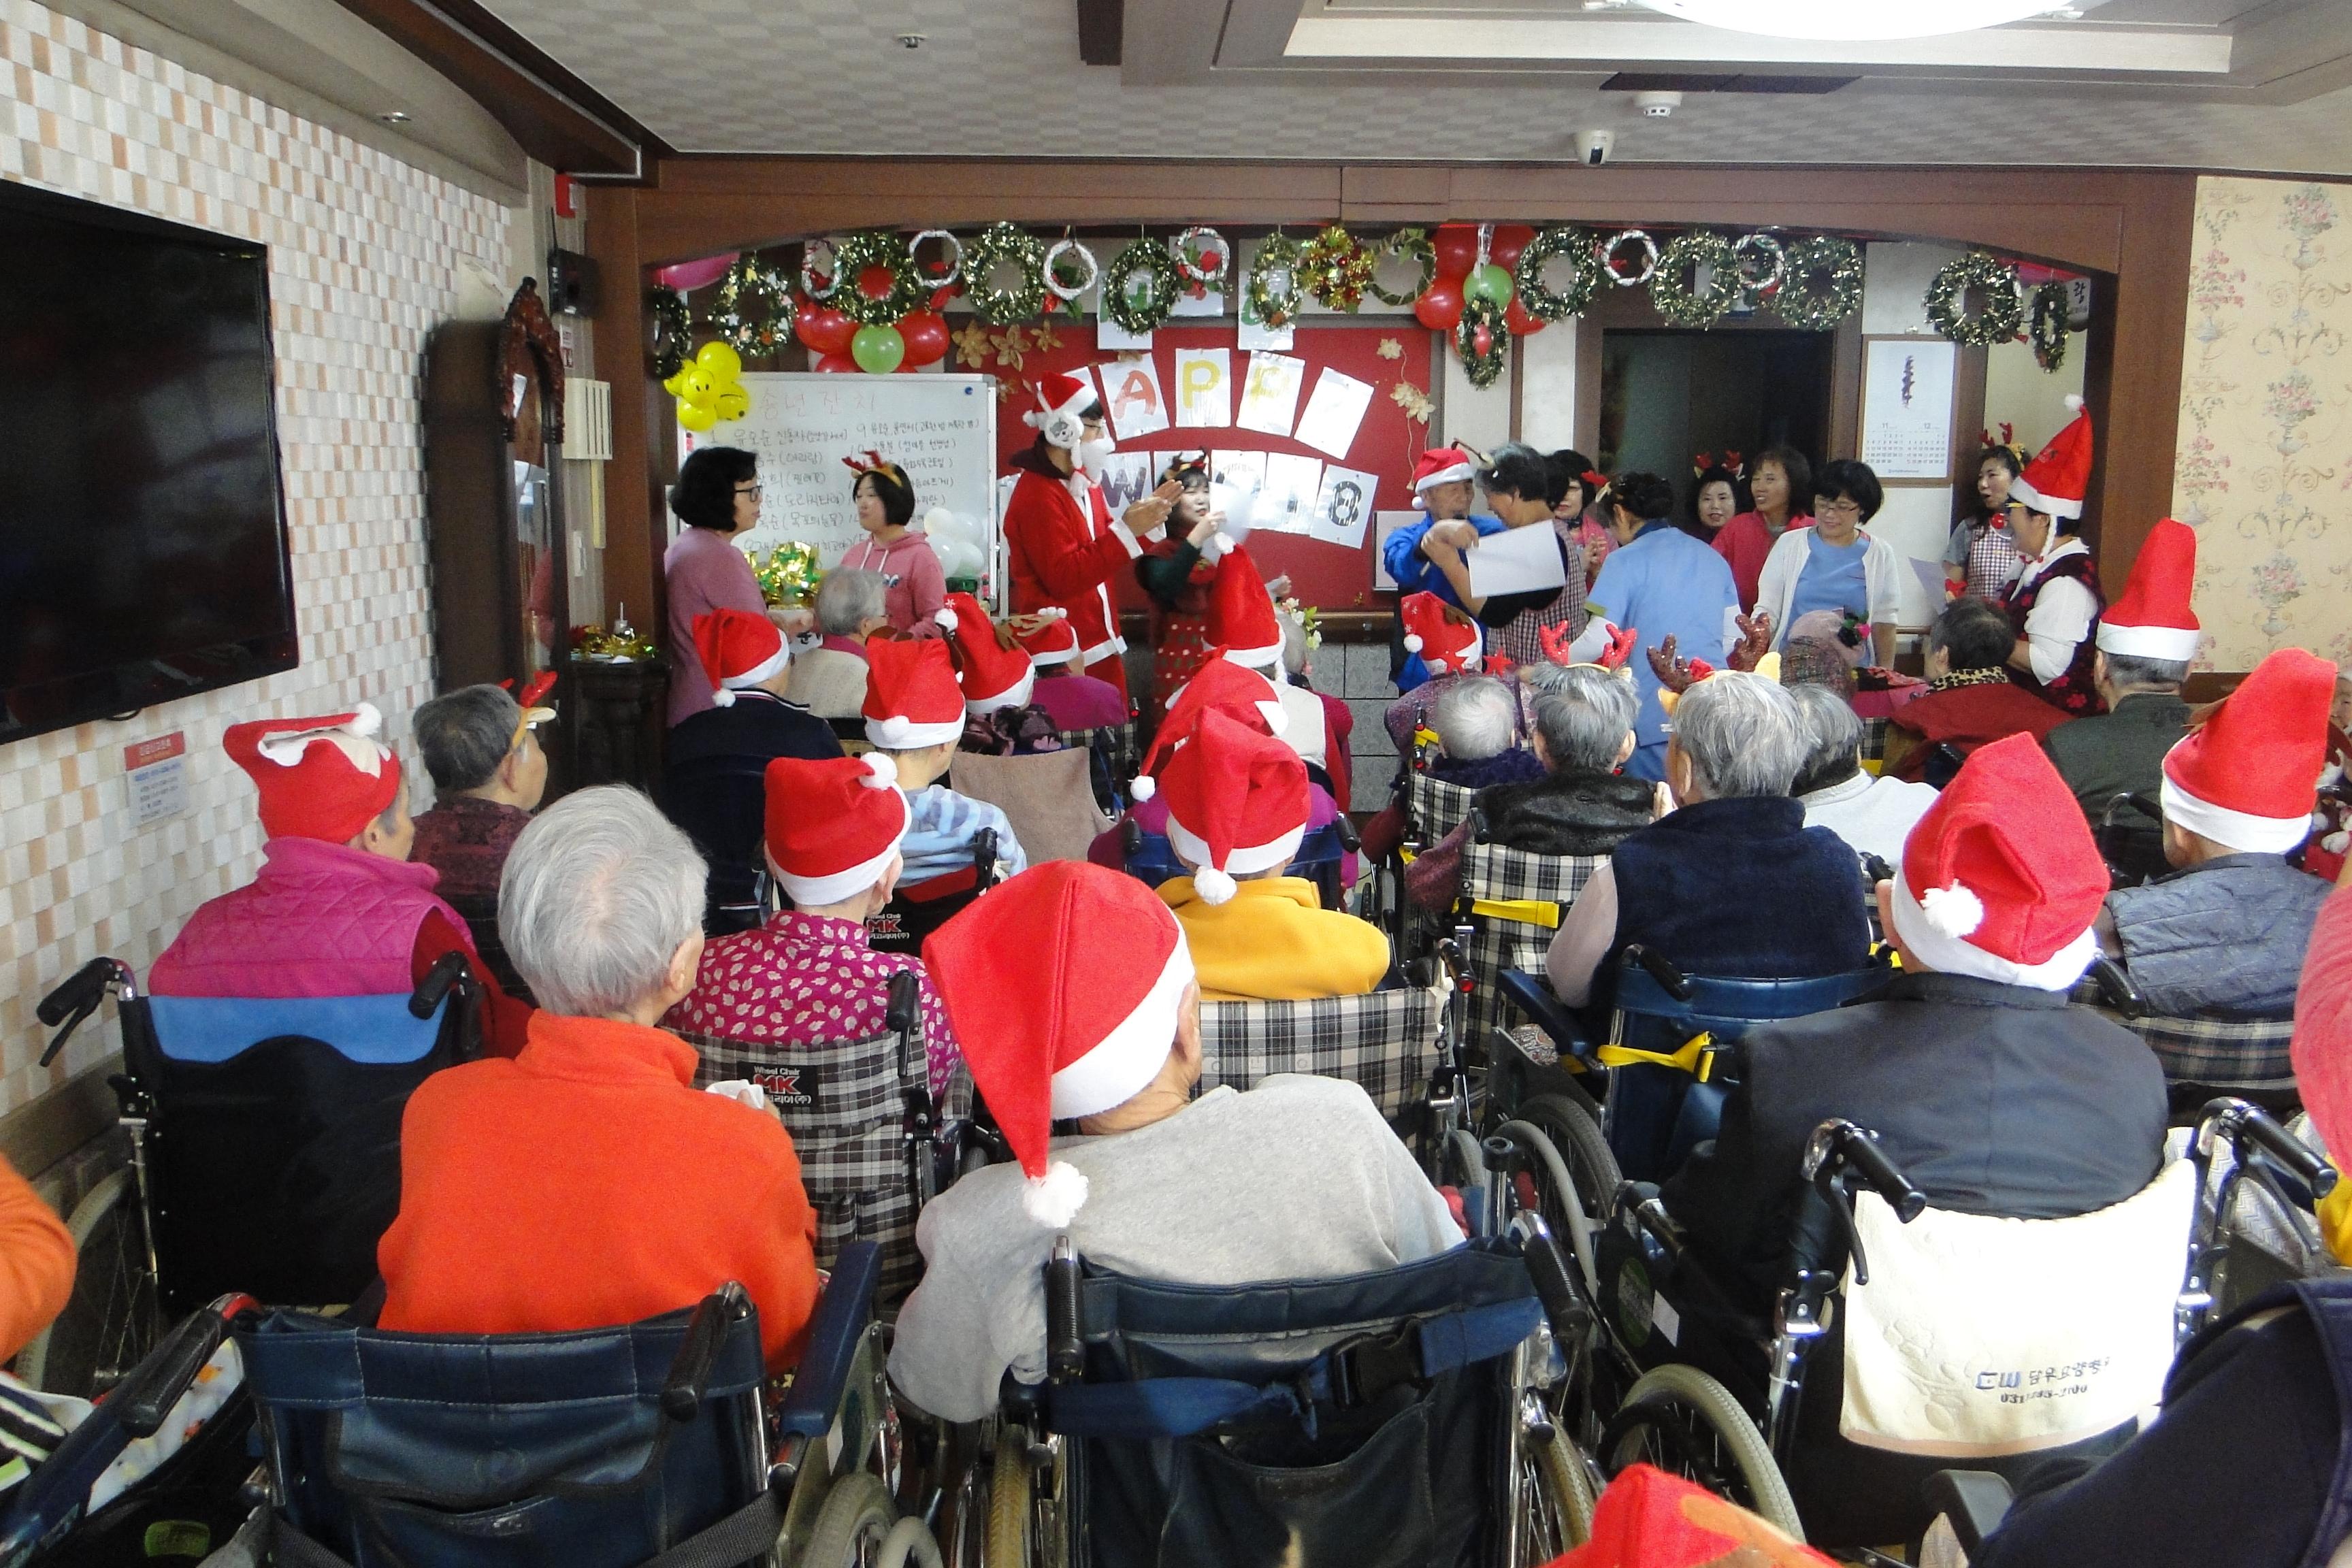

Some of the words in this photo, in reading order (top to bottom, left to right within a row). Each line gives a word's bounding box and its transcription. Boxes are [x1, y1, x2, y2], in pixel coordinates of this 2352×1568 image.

[753, 1065, 778, 1075] Wheel
[779, 1066, 800, 1076] Chair
[753, 1073, 802, 1095] MK
